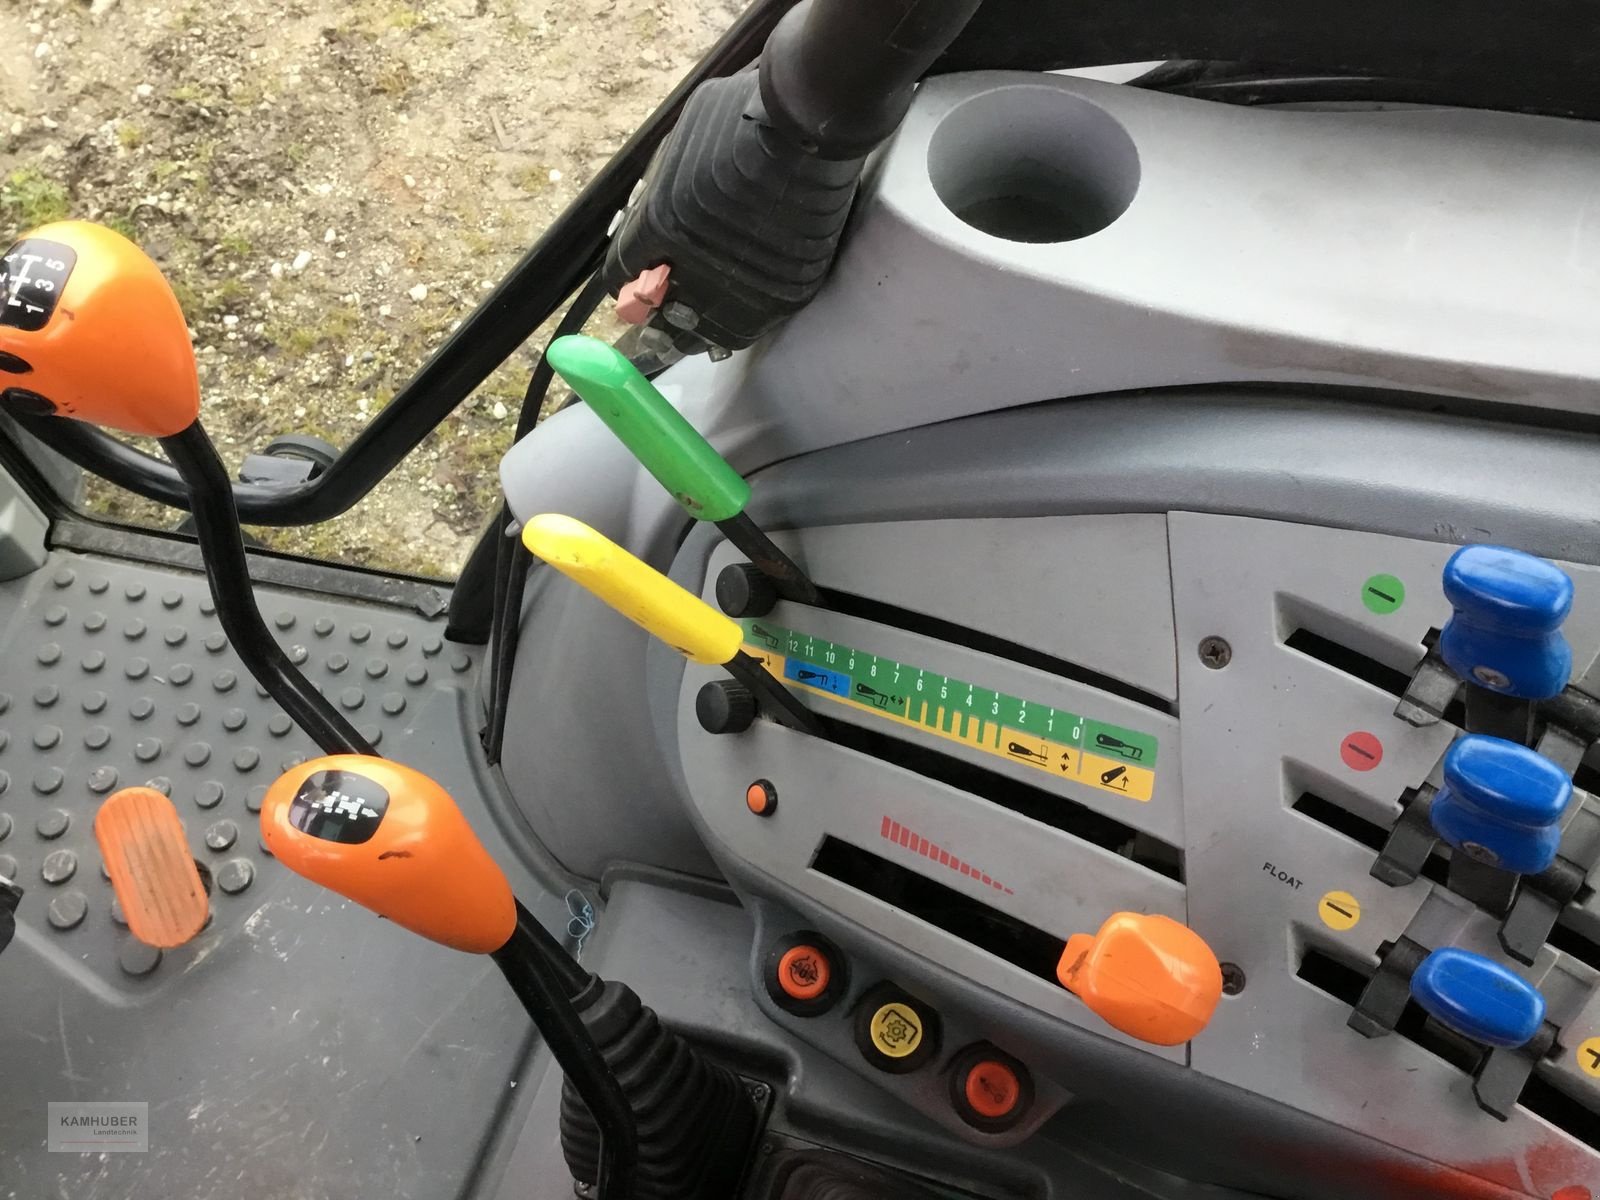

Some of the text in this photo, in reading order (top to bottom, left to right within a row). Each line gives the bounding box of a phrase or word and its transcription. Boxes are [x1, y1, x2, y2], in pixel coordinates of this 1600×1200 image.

[25, 258, 65, 313] 1 3 5
[788, 640, 1080, 739] 12 11 10 9 8 7 6 5 4 3 2 1 0
[1262, 862, 1303, 890] FLOAT
